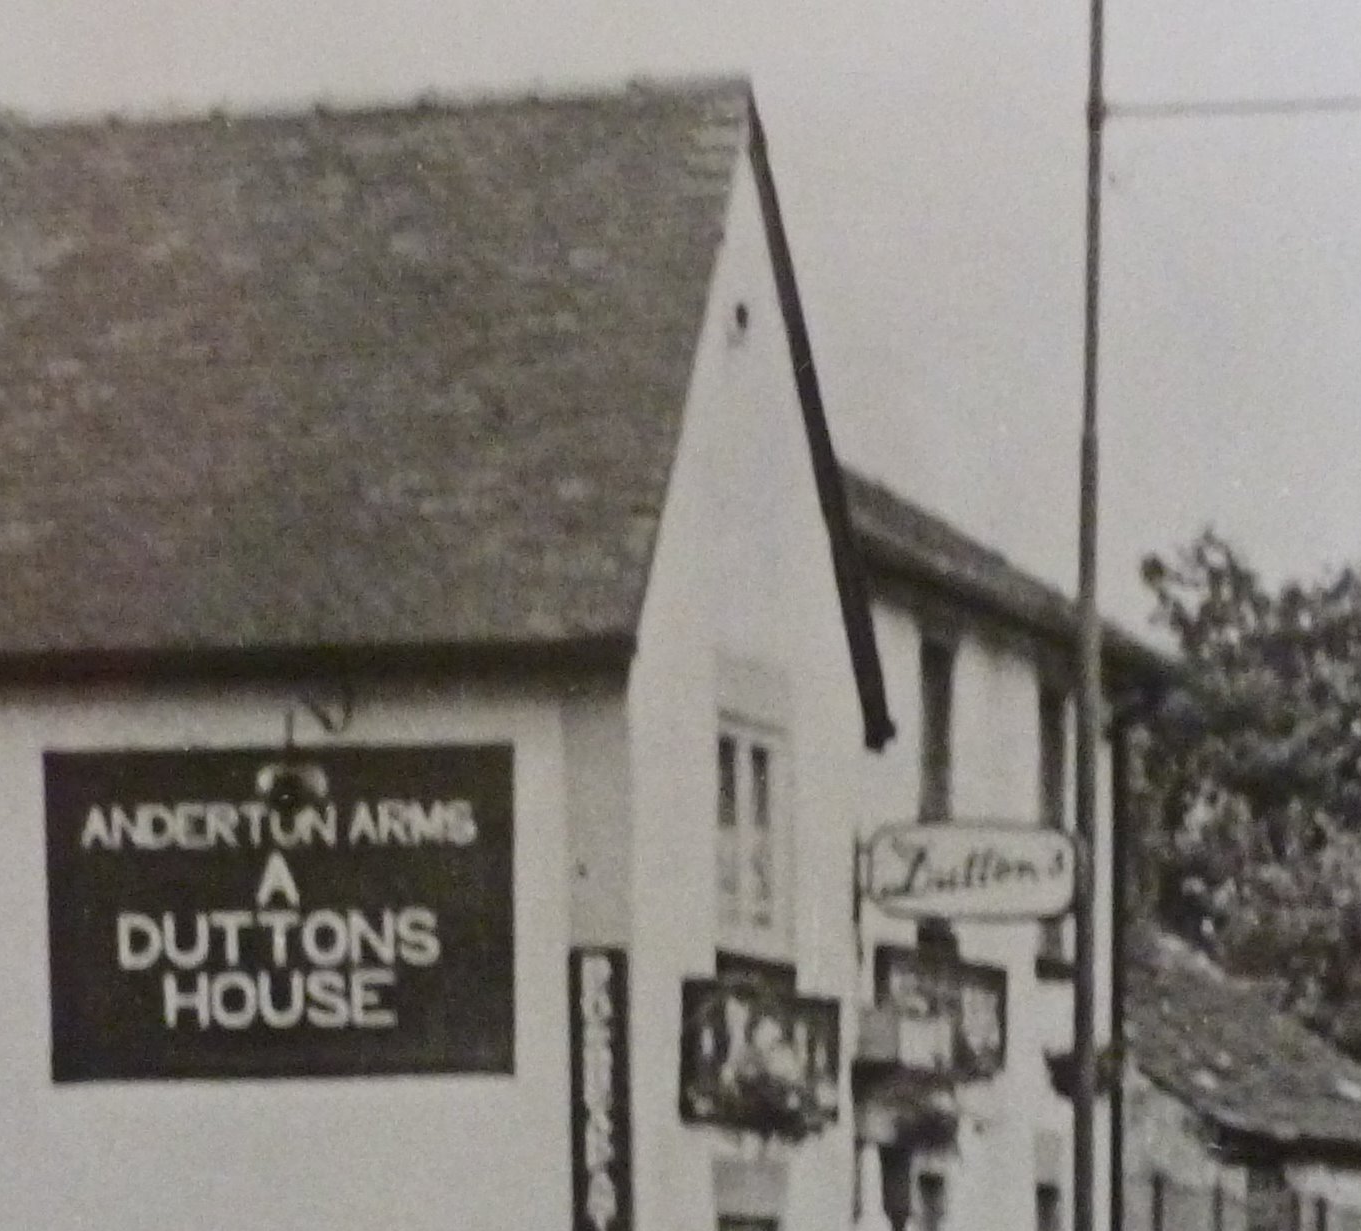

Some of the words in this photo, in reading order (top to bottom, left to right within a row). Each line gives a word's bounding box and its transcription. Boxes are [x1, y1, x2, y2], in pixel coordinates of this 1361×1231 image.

[81, 801, 337, 850] ANDERTON
[348, 799, 477, 846] ARMS
[255, 850, 301, 907] A
[116, 906, 441, 971] DUTTONS
[162, 968, 399, 1031] HOUSE
